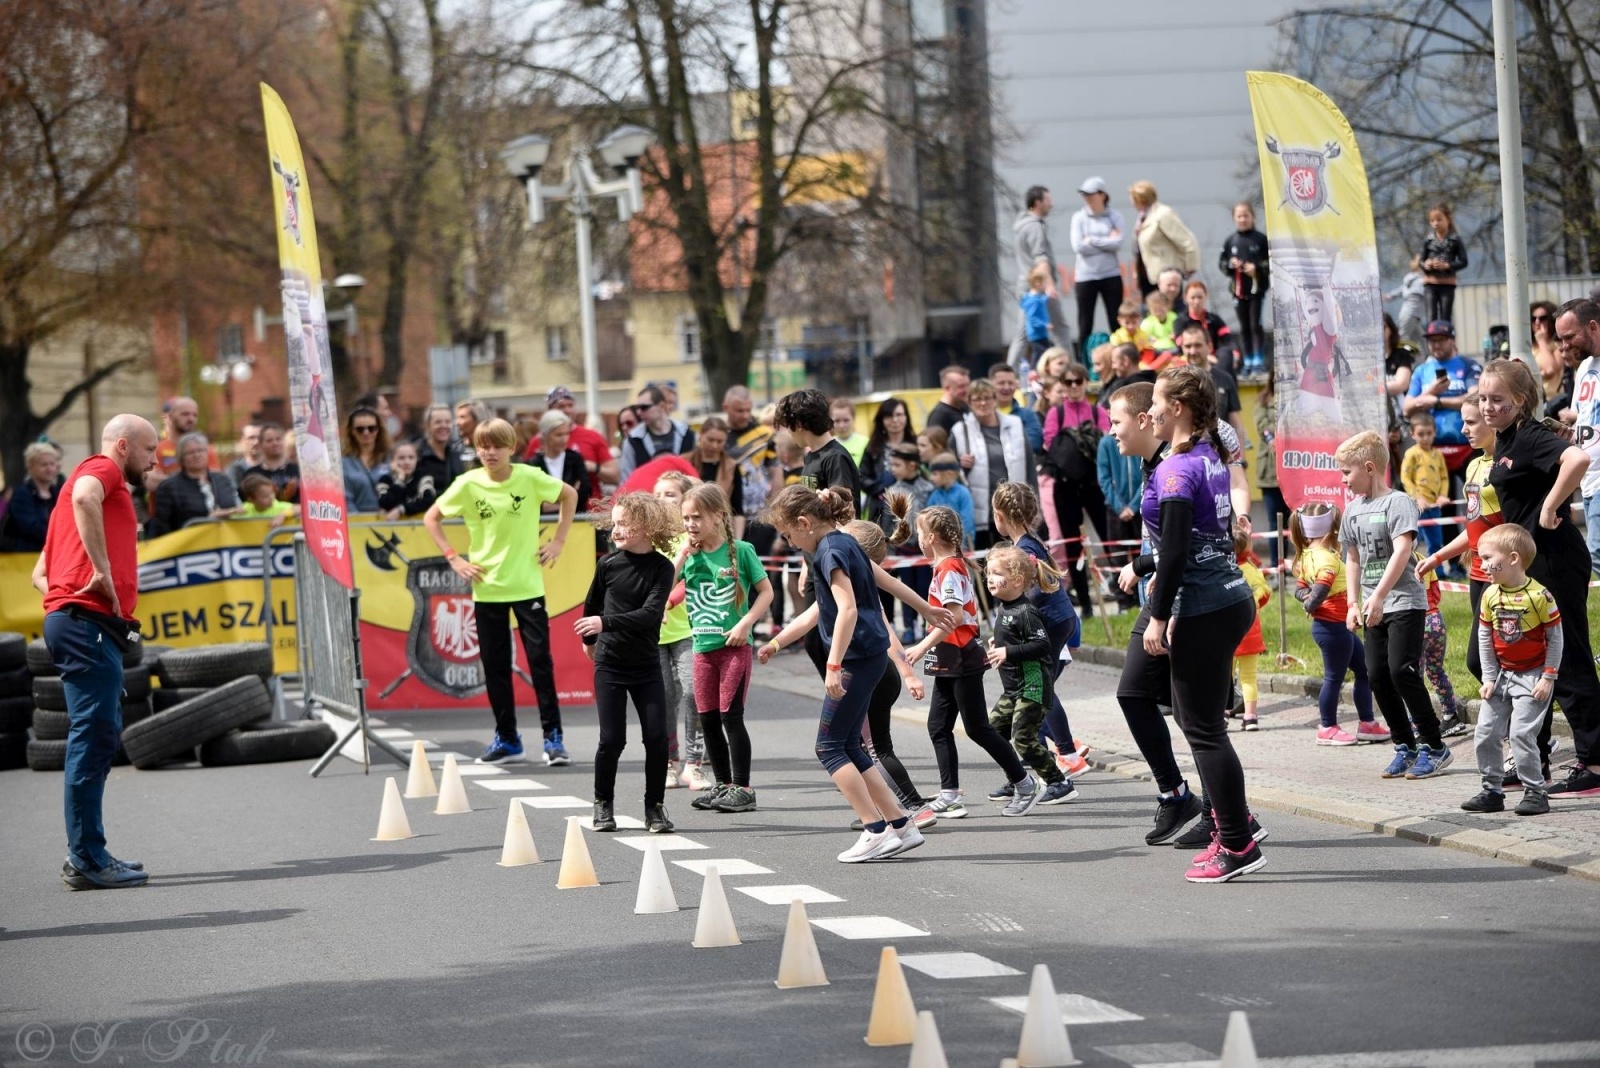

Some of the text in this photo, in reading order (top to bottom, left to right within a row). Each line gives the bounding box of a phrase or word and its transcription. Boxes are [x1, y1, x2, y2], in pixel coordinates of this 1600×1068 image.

[140, 600, 297, 642] JEM SZAL
[445, 666, 478, 685] OCR
